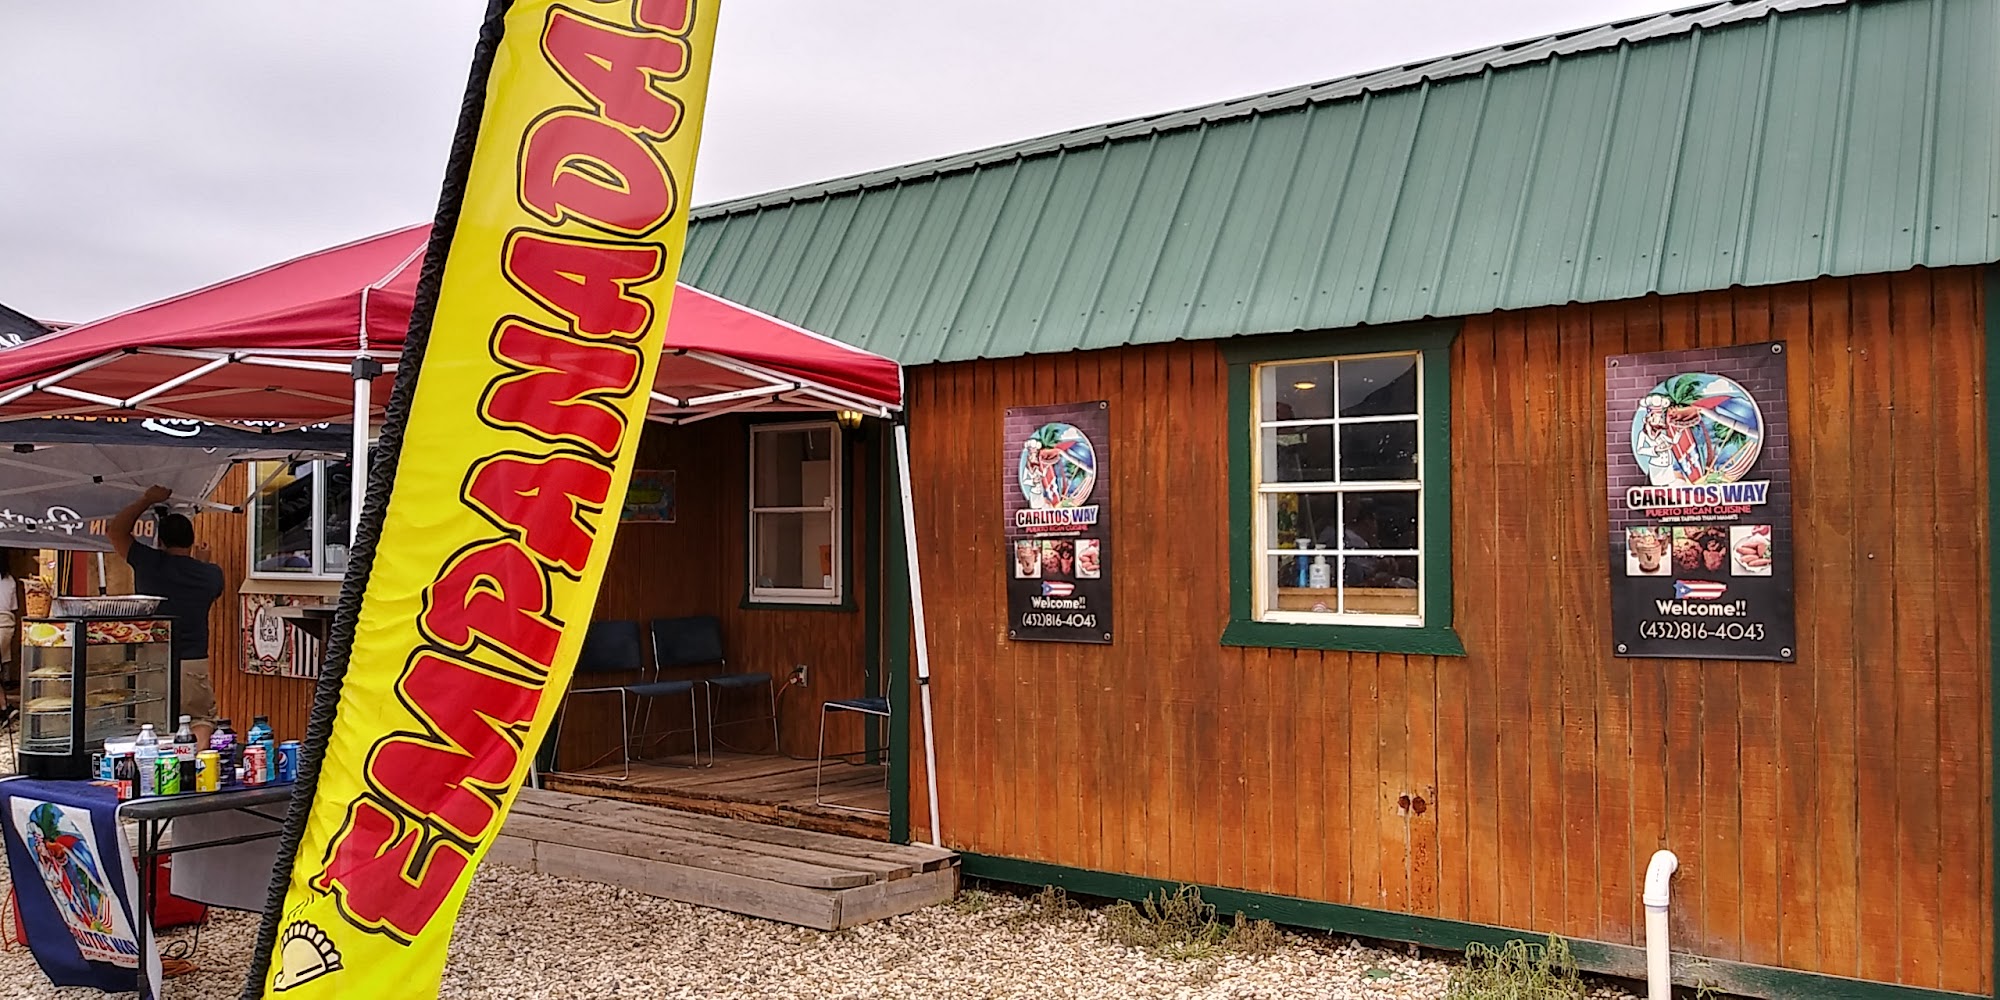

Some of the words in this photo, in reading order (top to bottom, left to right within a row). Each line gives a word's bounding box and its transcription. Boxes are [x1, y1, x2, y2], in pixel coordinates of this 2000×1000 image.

[313, 0, 697, 946] EMPANADA
[1629, 486, 1719, 507] CARLITOS
[1722, 483, 1767, 503] WAY
[1017, 509, 1070, 526] CARLITOS
[1072, 507, 1097, 523] WAY
[1645, 507, 1682, 517] PUERTO
[1683, 505, 1712, 515] RICAN
[1713, 504, 1752, 514] CUISINE
[1031, 596, 1087, 610] Welcome!!
[1655, 599, 1748, 617] Welcome!!
[1022, 612, 1097, 628] (432)816-4043
[1639, 620, 1766, 641] (432)816-4043
